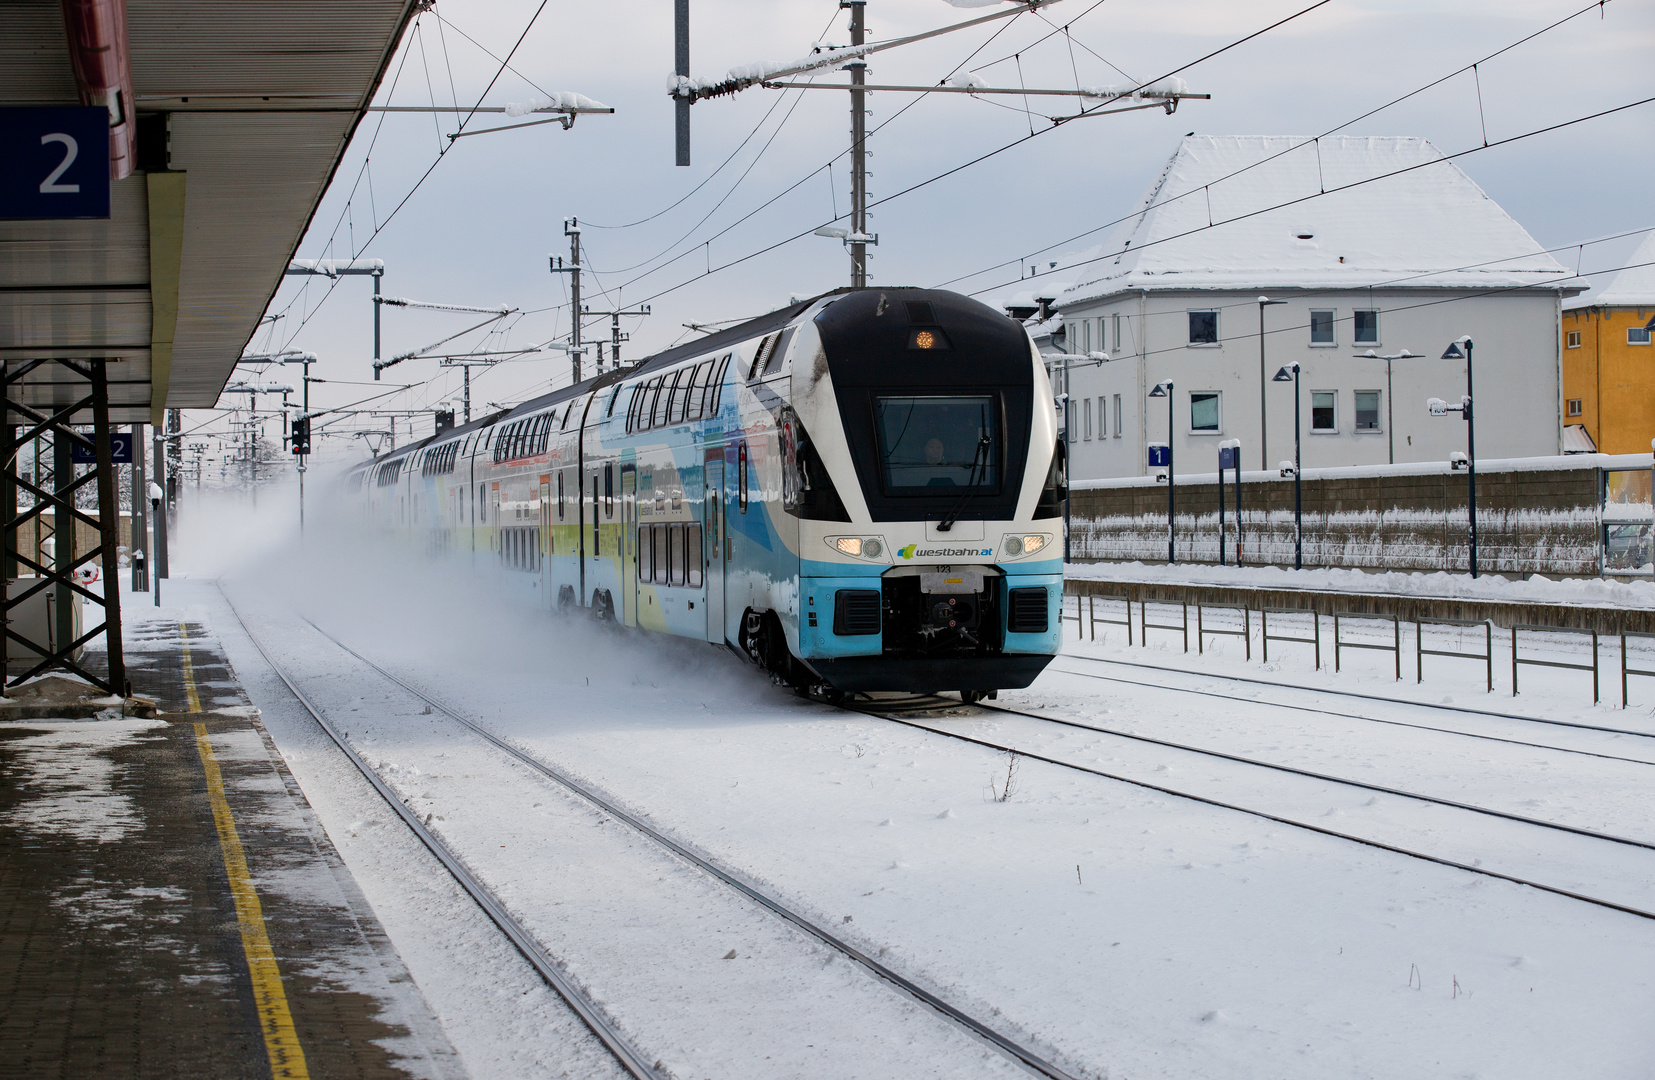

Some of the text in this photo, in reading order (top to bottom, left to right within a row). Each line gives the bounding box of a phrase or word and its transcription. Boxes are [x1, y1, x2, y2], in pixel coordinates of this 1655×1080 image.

[39, 132, 80, 194] 2
[113, 440, 125, 457] 2
[1155, 450, 1162, 464] 1
[915, 547, 993, 557] westbahn.at
[935, 565, 951, 573] 123
